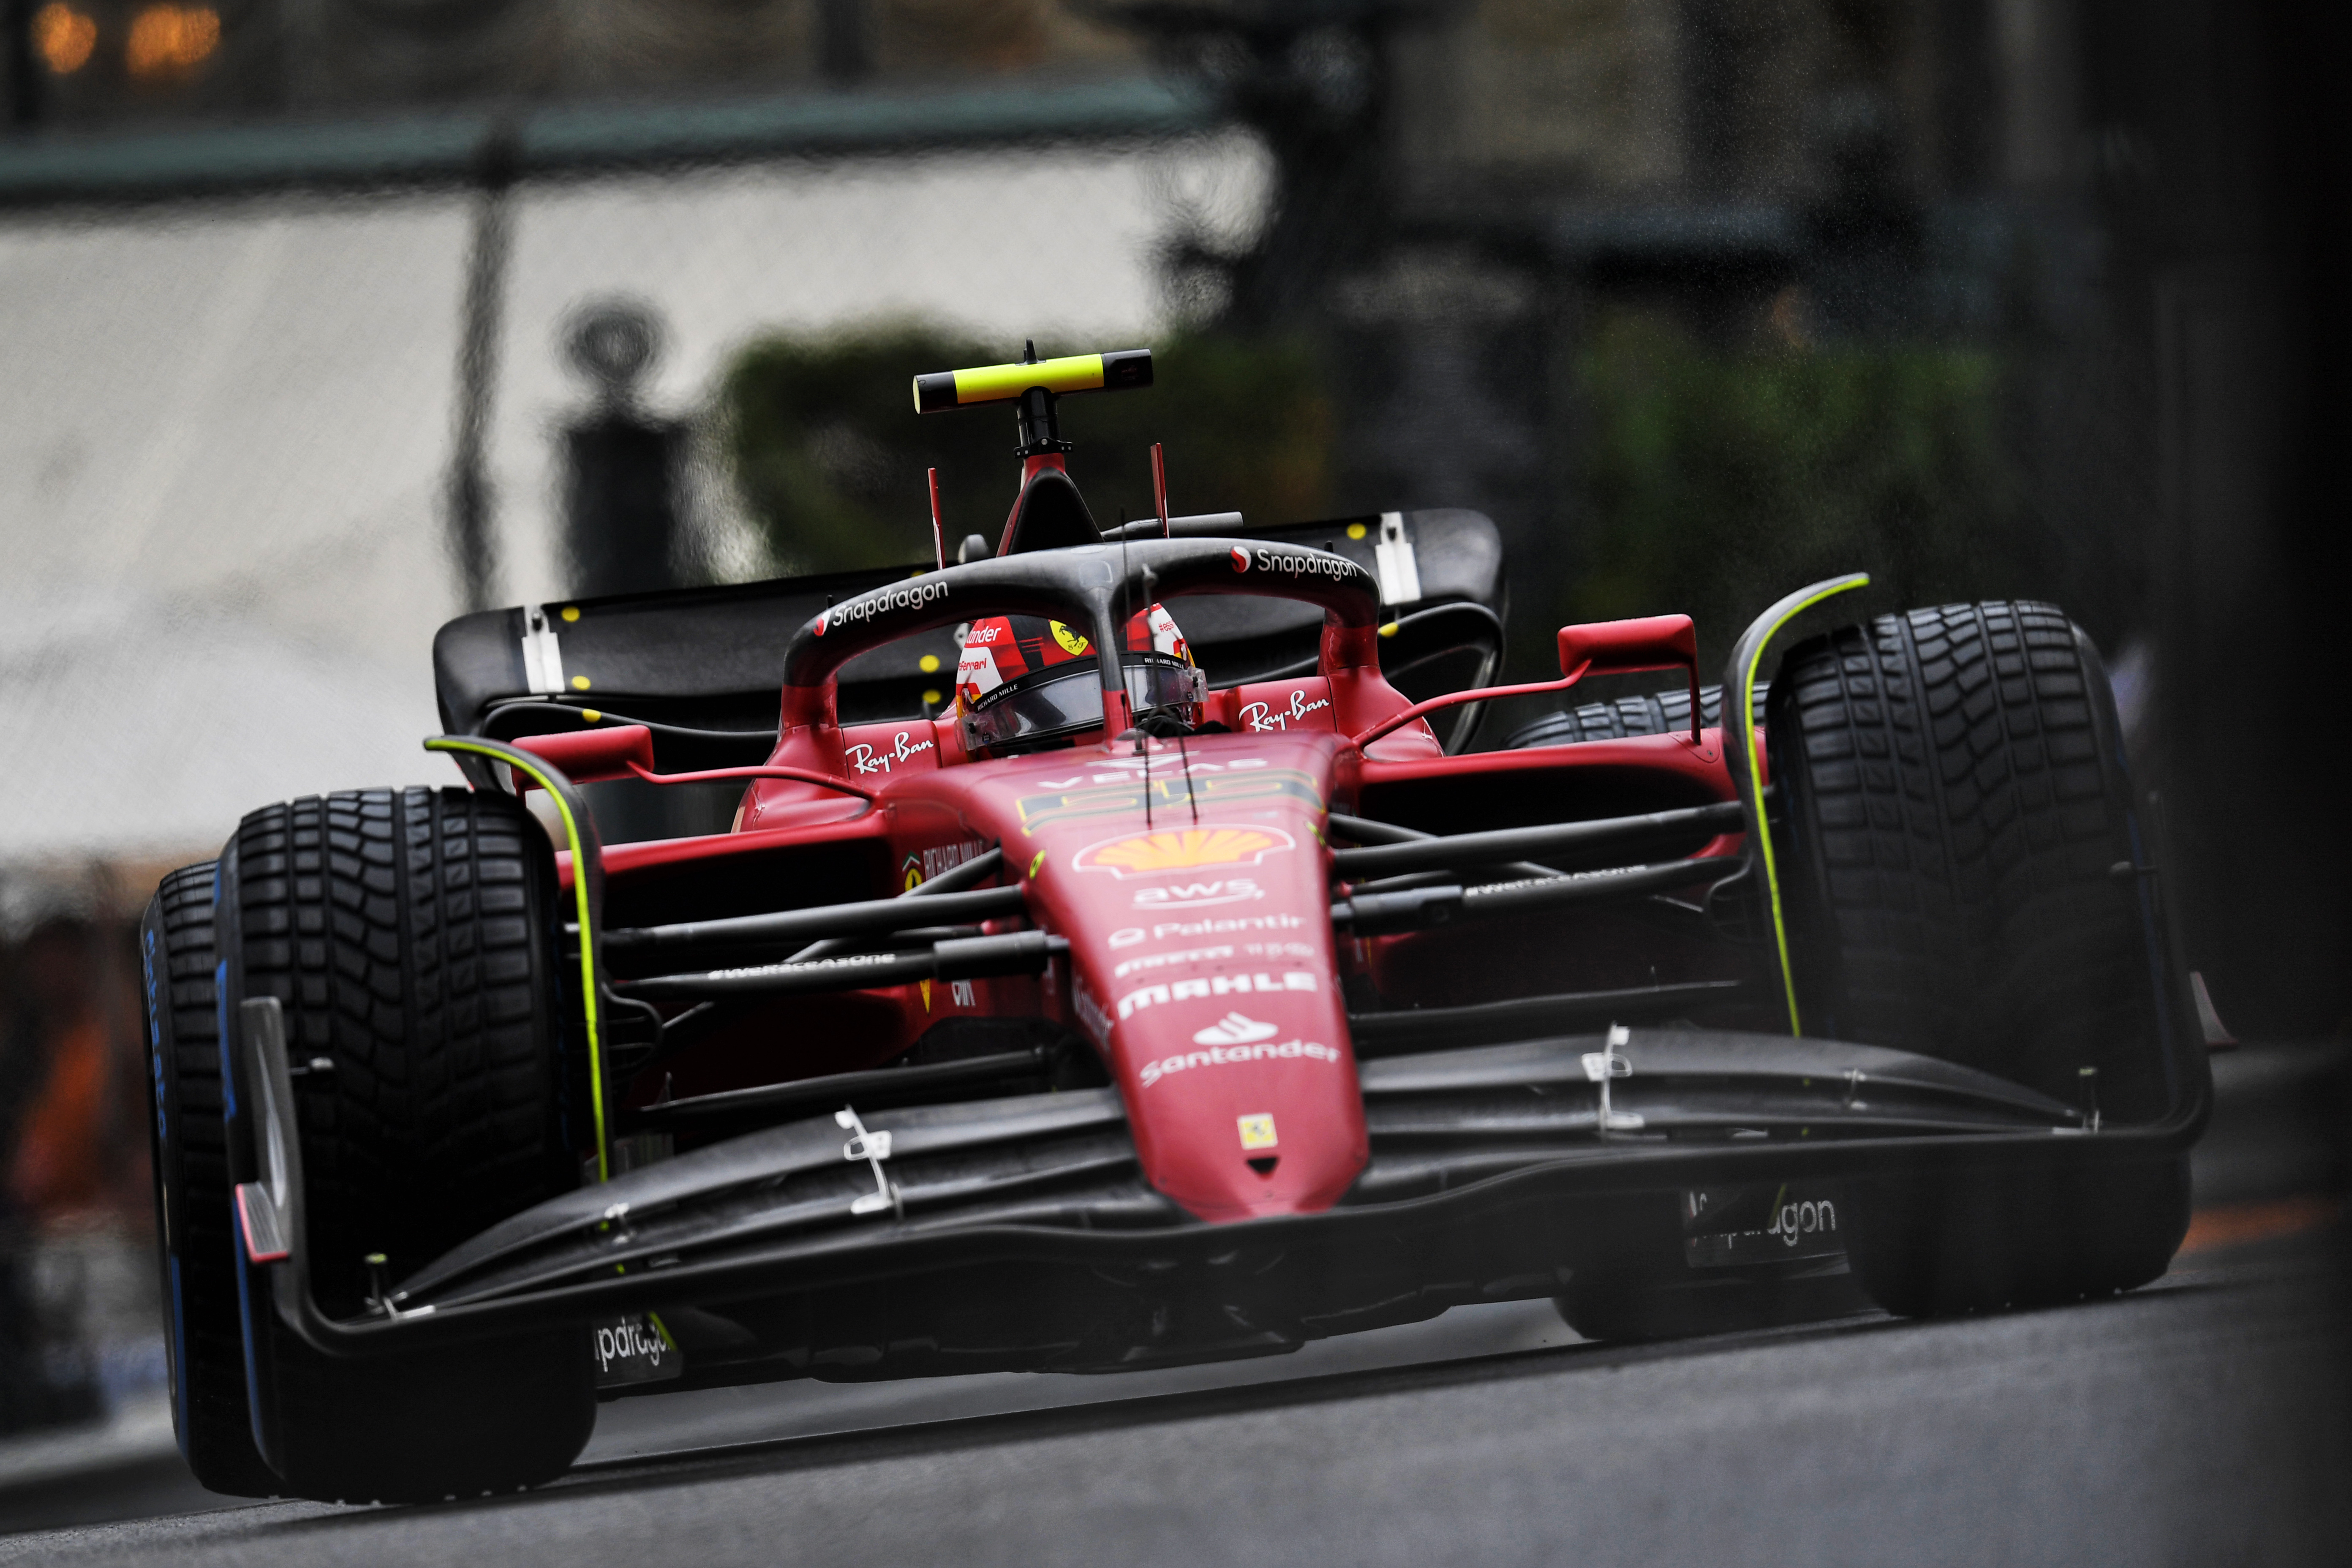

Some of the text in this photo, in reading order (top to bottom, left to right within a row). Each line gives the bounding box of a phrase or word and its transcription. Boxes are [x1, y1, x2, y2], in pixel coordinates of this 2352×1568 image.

[1257, 549, 1357, 582] Snapdragon
[833, 581, 949, 626] Snapdragon
[977, 683, 1018, 711] RICHARD MILLE
[1239, 690, 1329, 732] Ray-Ban
[845, 732, 934, 774] Ray-Ban
[1154, 914, 1306, 939] Palantir
[1117, 972, 1318, 1020] MAHLE
[1140, 1039, 1340, 1088] Santander
